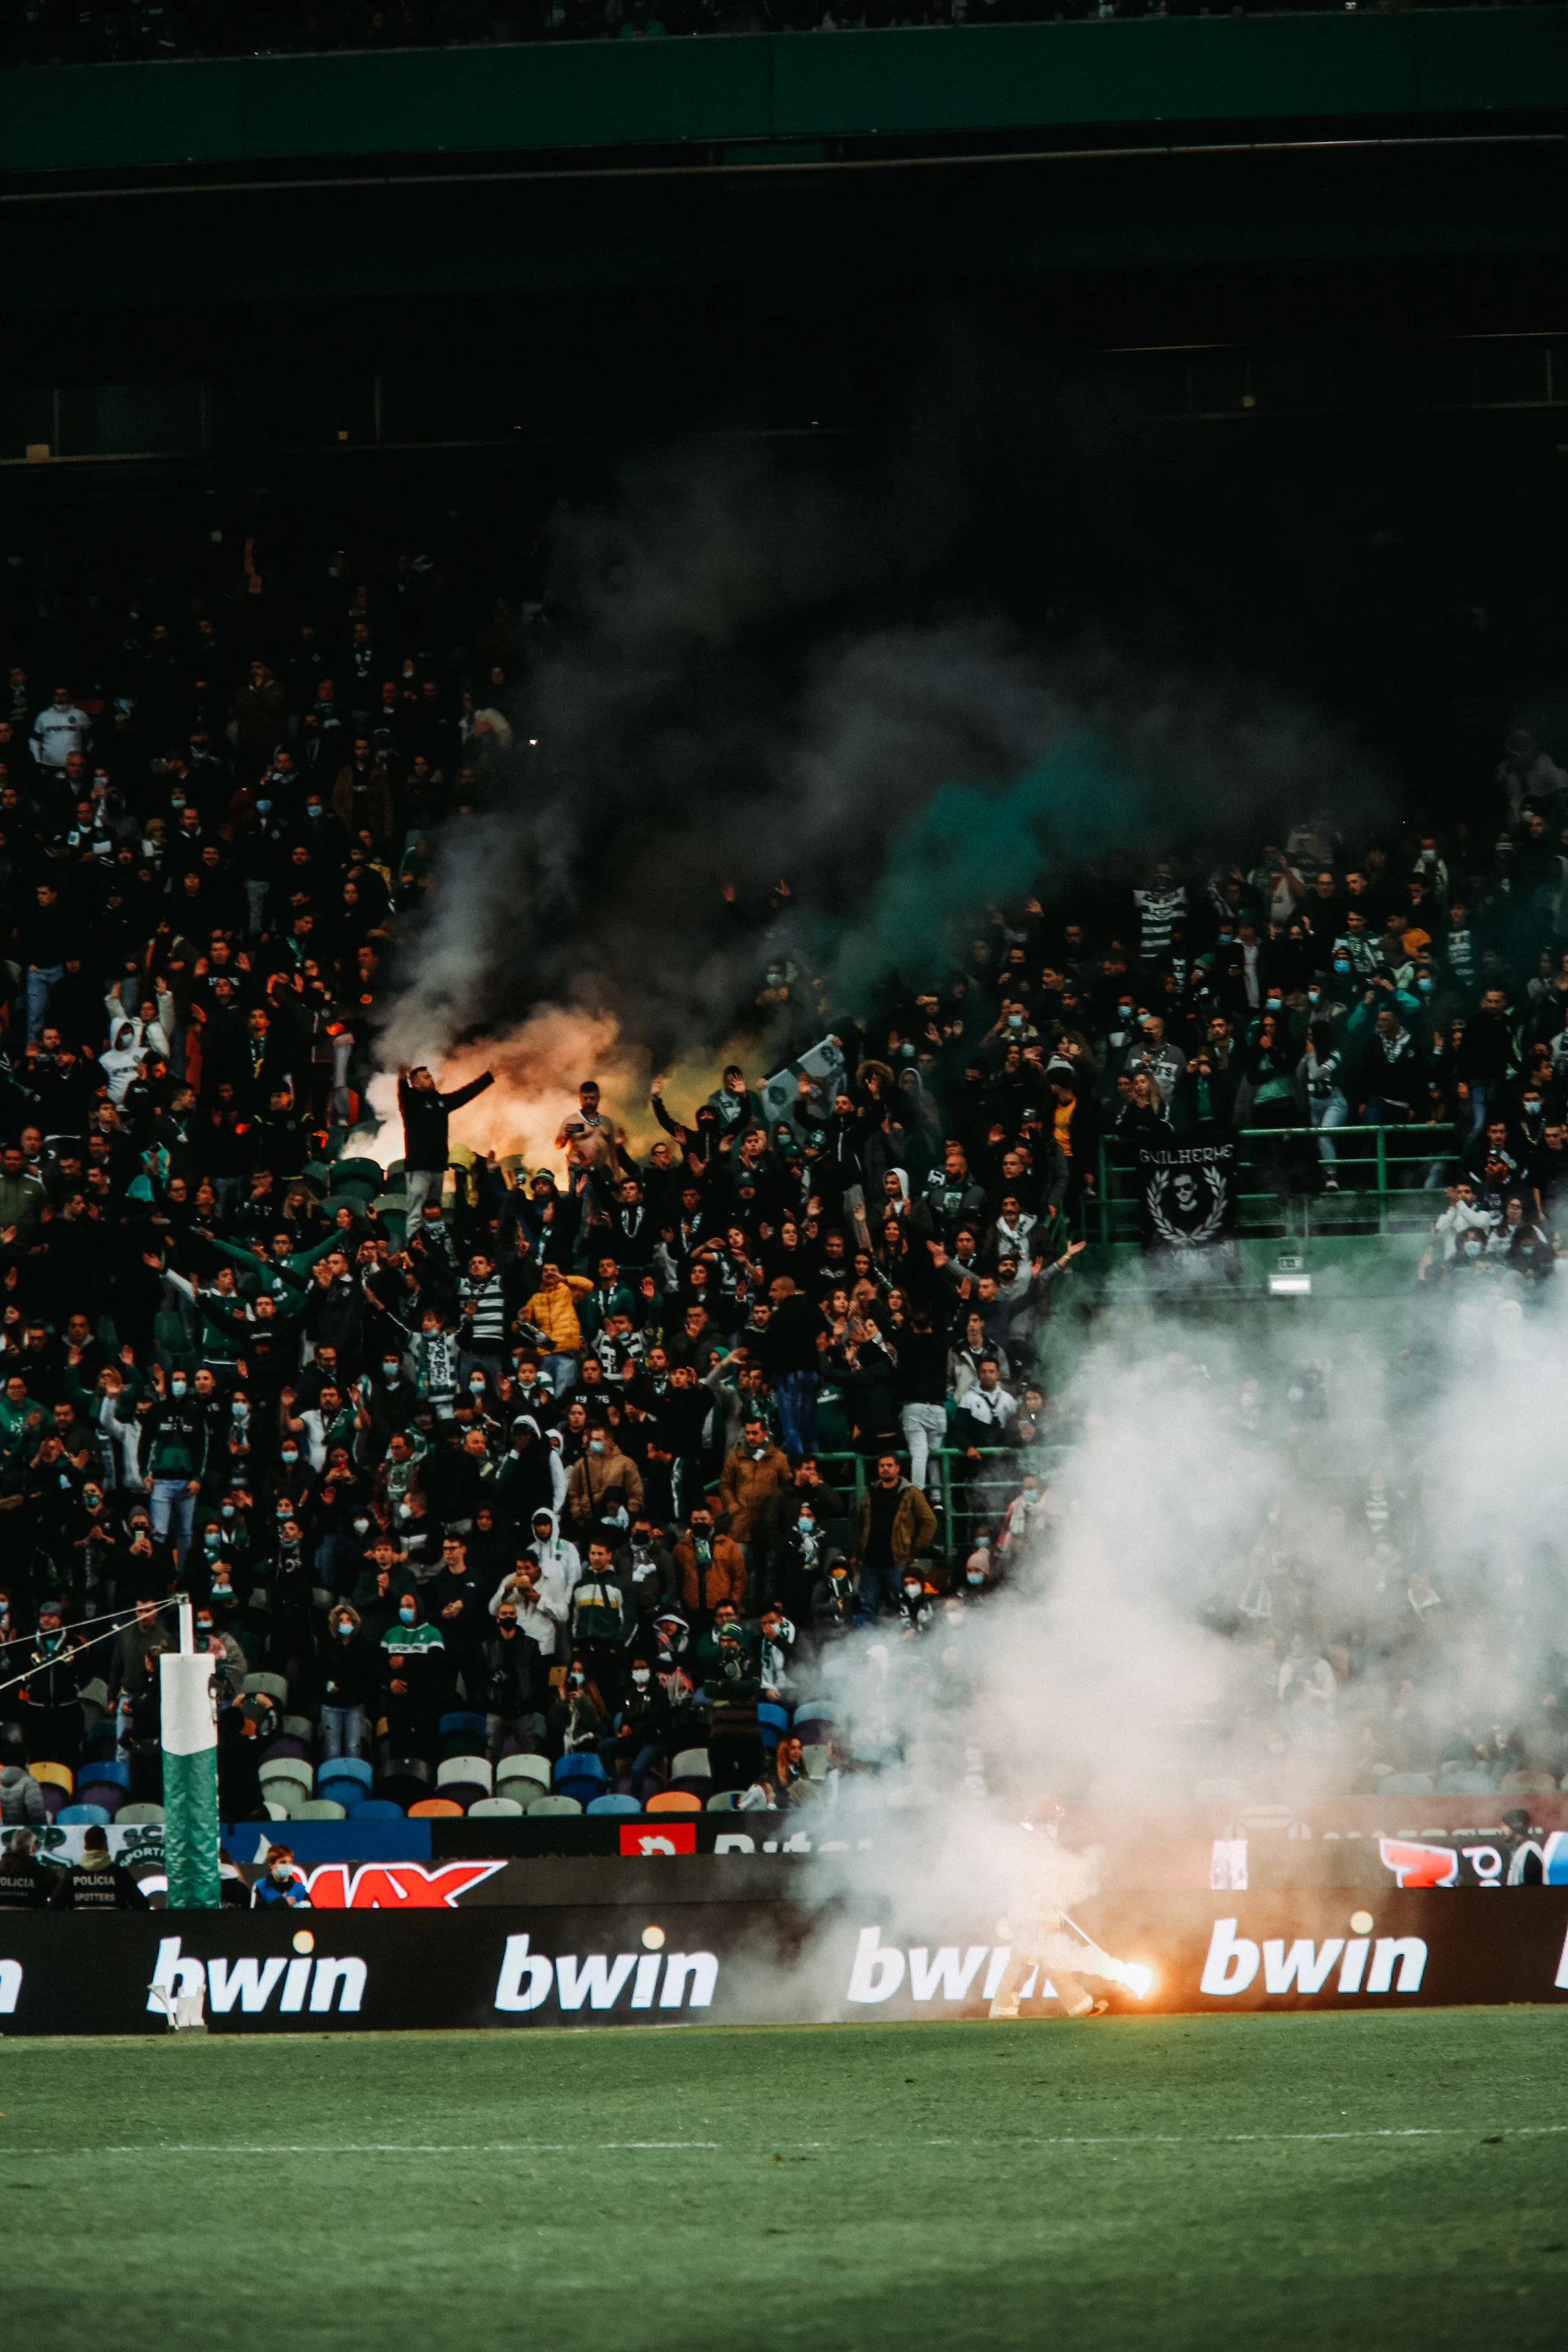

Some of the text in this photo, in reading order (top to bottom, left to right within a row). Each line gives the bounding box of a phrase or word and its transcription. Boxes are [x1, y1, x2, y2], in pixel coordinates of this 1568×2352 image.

[1139, 1144, 1234, 1164] GUILHERME
[575, 1395, 610, 1404] 19 76
[73, 1873, 116, 1886] POLÍCIA
[74, 1893, 116, 1903] SPOTTERS
[1200, 1911, 1428, 1995] bwin
[146, 1929, 368, 2013] bwin
[494, 1925, 719, 2012] bwin
